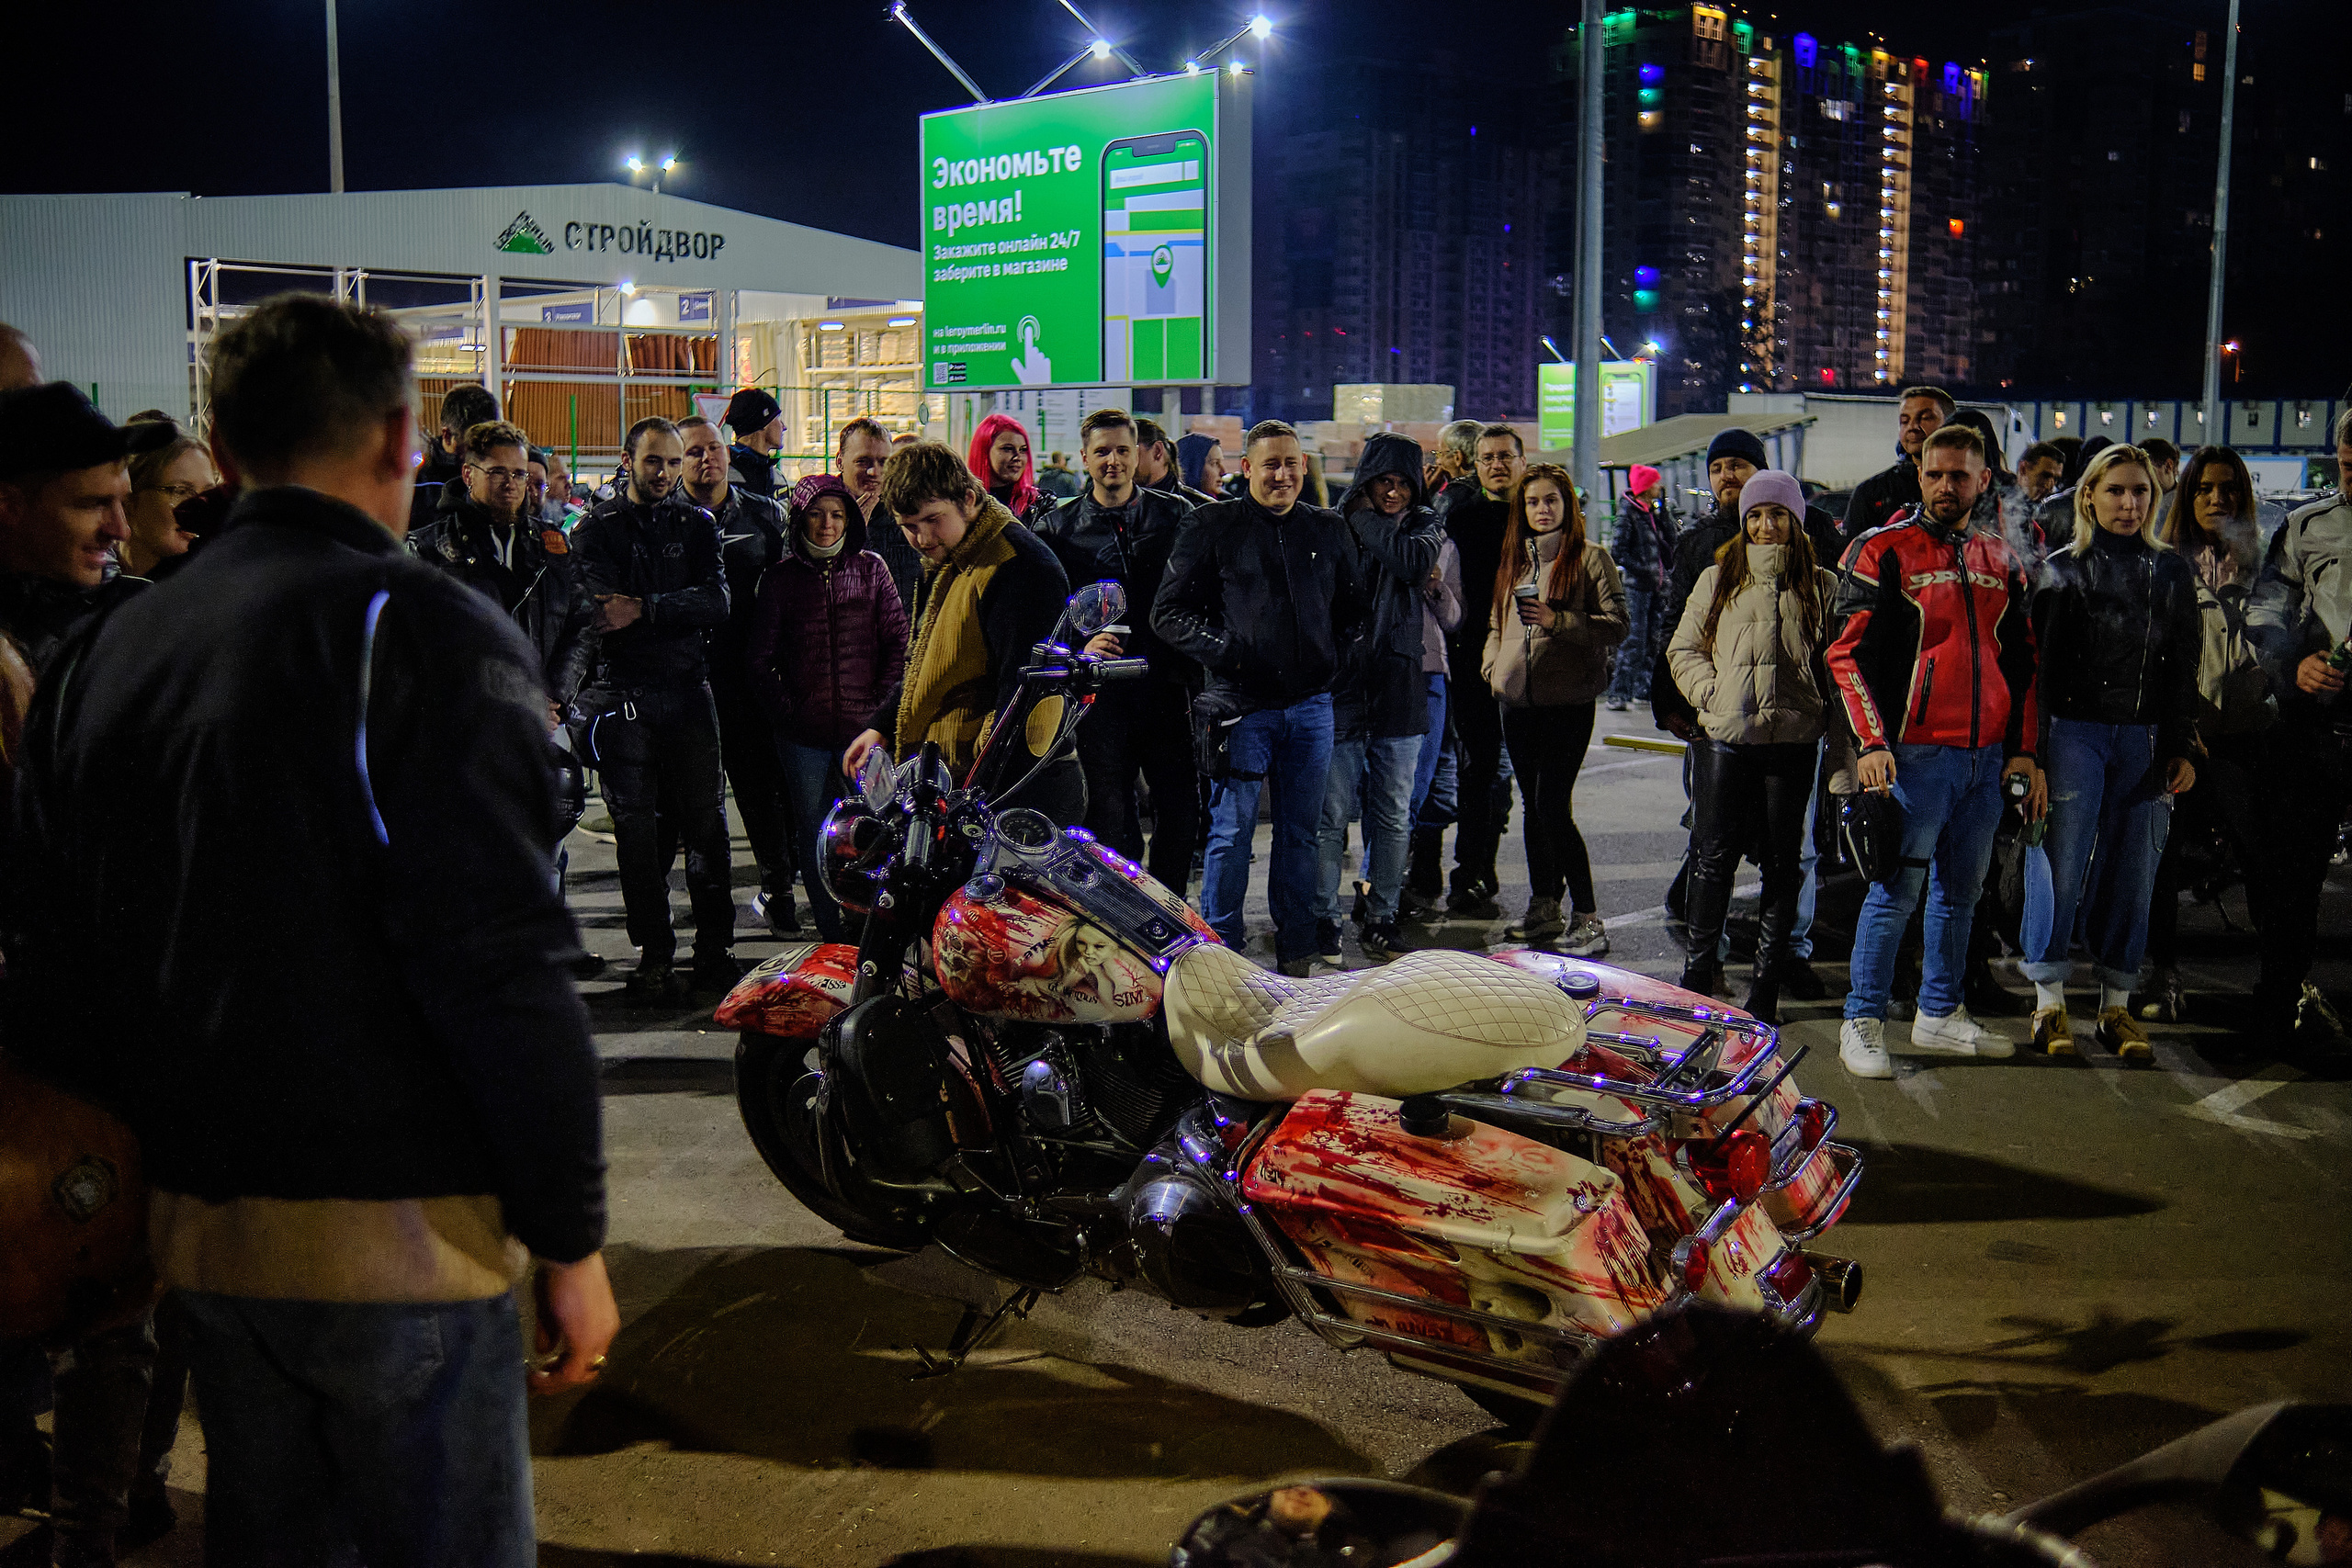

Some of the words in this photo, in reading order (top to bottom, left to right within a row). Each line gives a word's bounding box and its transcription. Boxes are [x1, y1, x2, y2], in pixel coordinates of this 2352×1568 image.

[933, 144, 1082, 189] Экономьте
[933, 189, 1022, 237] время!
[565, 220, 727, 263] СТРОЙДВОР
[933, 242, 996, 260] Закажите
[998, 233, 1047, 254] онлайн
[1049, 230, 1080, 249] 24/7
[933, 263, 991, 283] заберите
[992, 264, 1001, 276] в
[1002, 257, 1069, 276] магазине
[681, 299, 690, 314] 2
[933, 328, 944, 338] на
[944, 322, 1006, 339] leroymerlin.ru
[933, 344, 940, 355] и
[947, 342, 1006, 356] приложении
[1847, 671, 1882, 738] SPIDI
